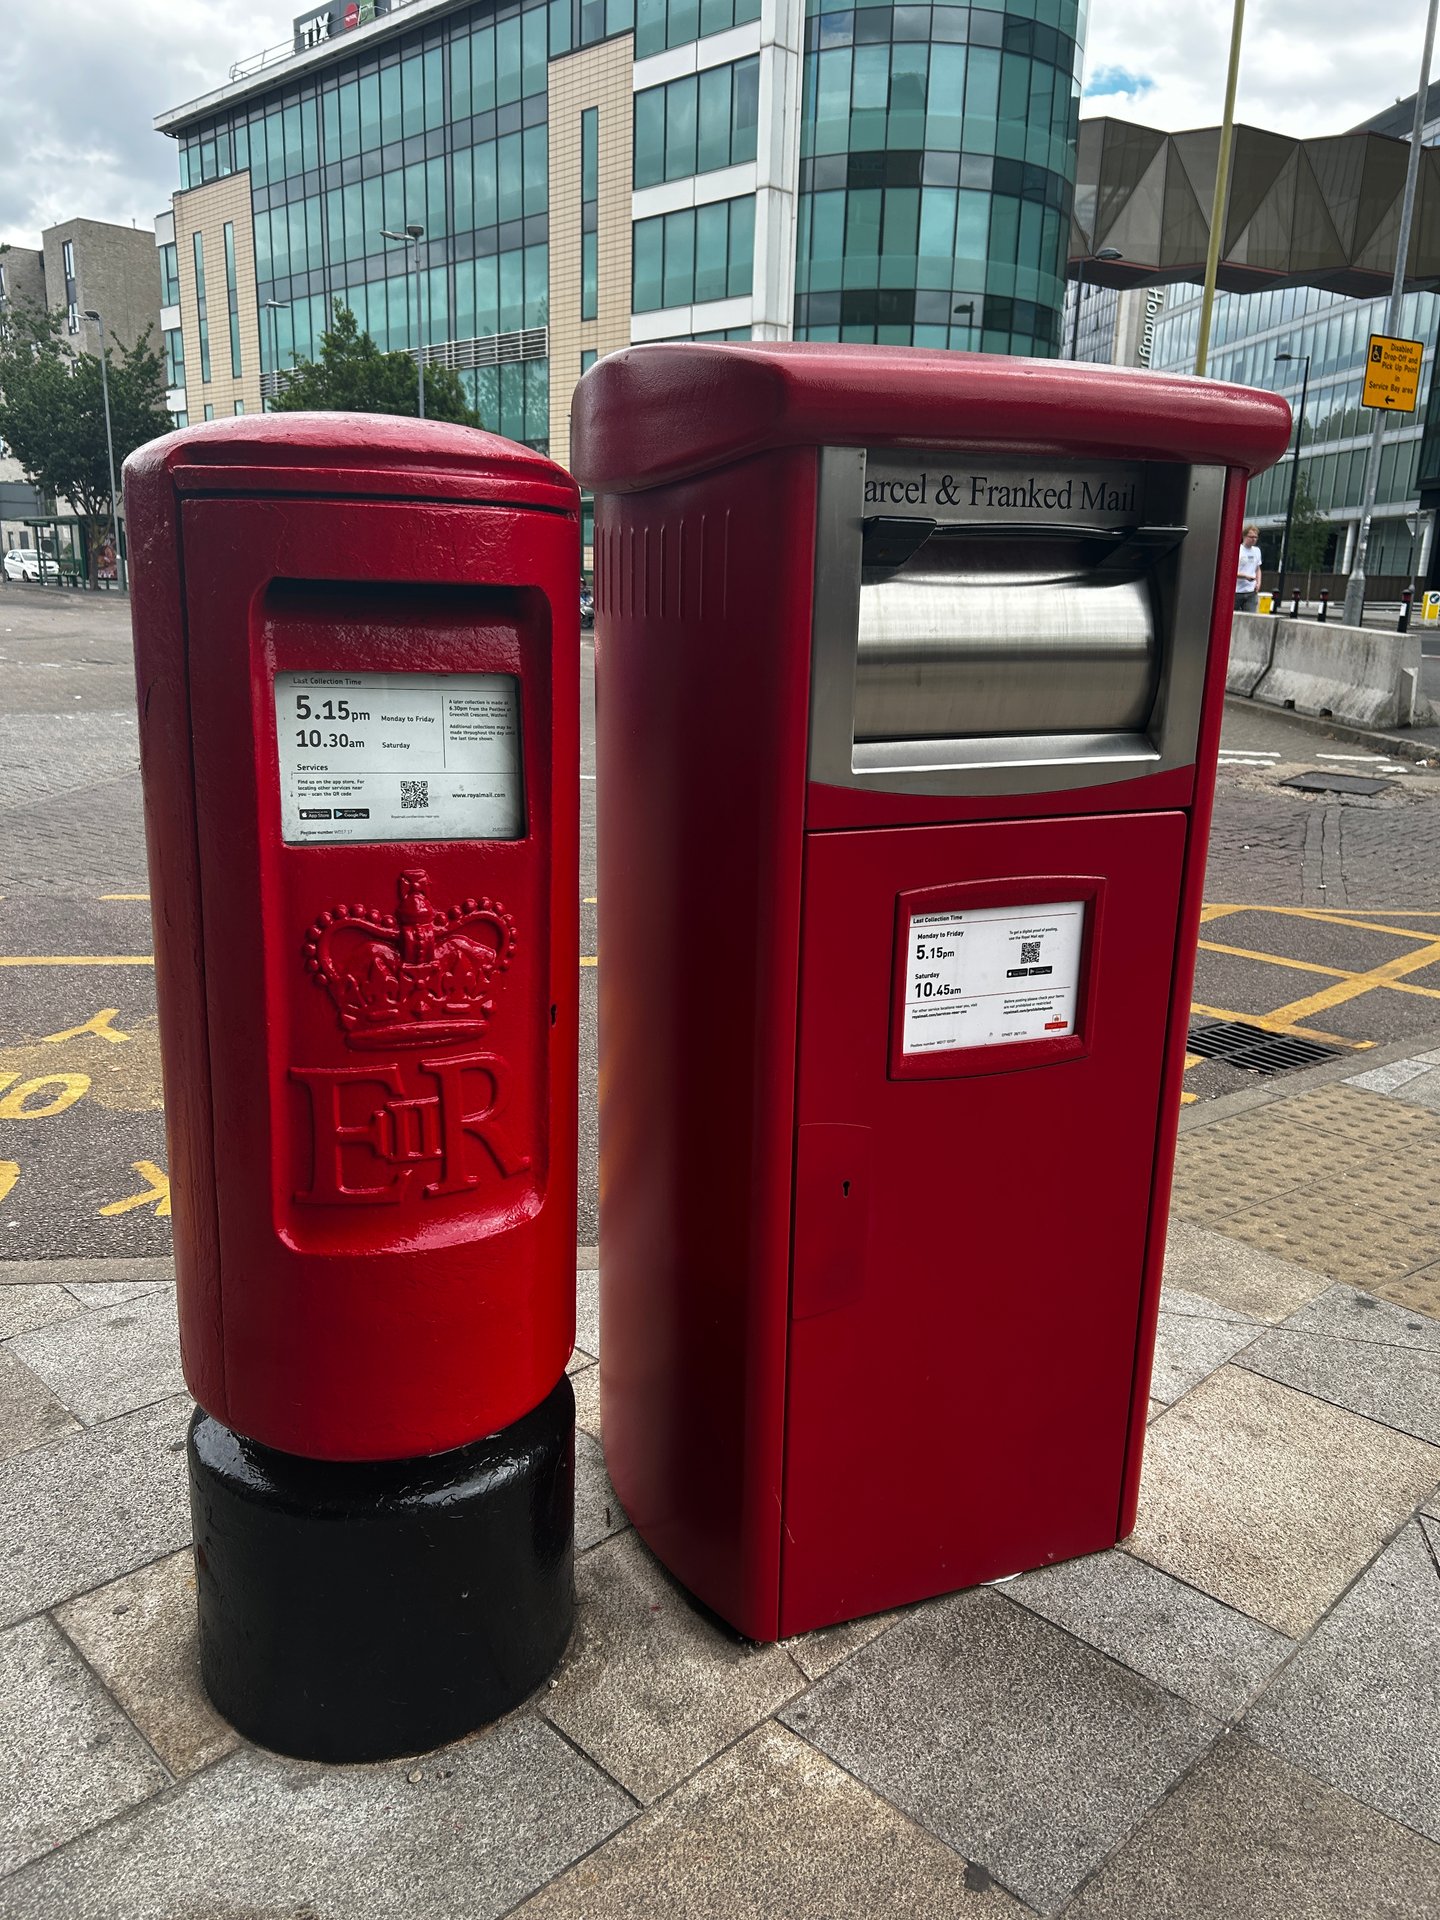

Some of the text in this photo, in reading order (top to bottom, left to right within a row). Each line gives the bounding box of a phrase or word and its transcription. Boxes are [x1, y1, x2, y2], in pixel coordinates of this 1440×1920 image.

[1391, 343, 1413, 354] Disabled
[1384, 352, 1407, 362] Drop-Off
[1382, 361, 1417, 373] Pick Up Point
[1369, 381, 1388, 391] Service
[1390, 384, 1401, 394] Bay
[864, 474, 1136, 512] arcel & Franked Mail
[296, 695, 370, 722] 5.15pm
[296, 730, 364, 748] 10.30am
[916, 944, 954, 960] 5.15pm
[915, 982, 961, 998] 10.45am
